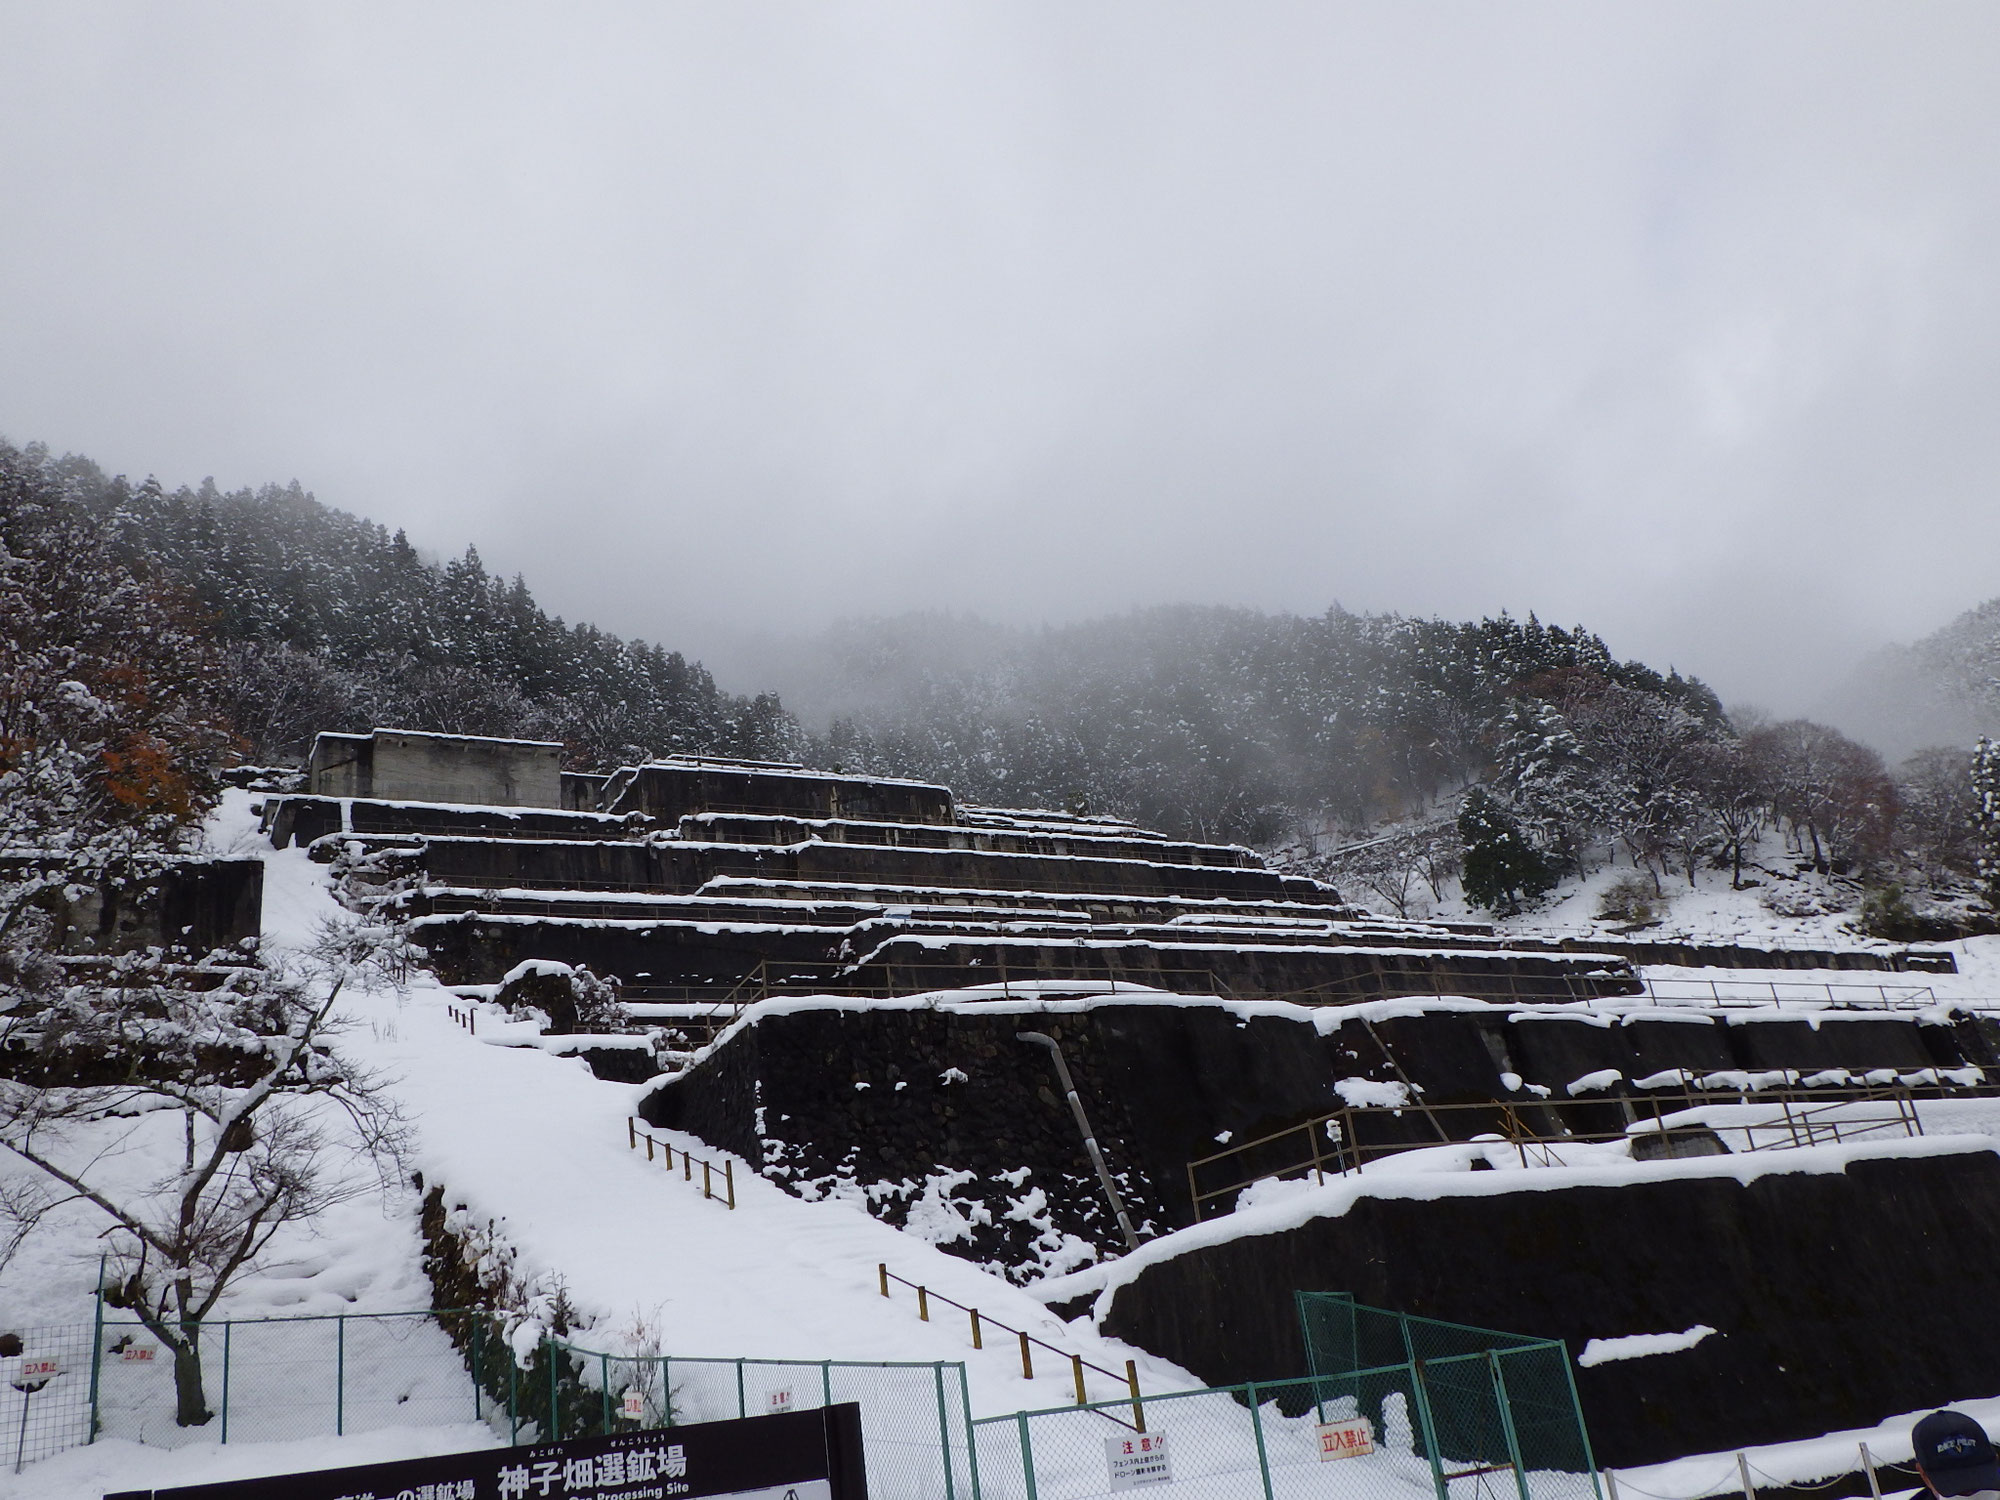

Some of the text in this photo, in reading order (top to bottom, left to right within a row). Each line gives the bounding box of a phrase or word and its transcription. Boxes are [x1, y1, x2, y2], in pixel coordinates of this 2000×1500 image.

[124, 1350, 154, 1360] 立入禁止
[24, 1362, 56, 1375] 立入禁止
[610, 1433, 666, 1448] せんこうじょう
[1322, 1427, 1369, 1452] 立入禁止
[529, 1447, 564, 1459] みこばた
[497, 1444, 688, 1500] 神子畑選鉱場
[666, 1482, 690, 1495] Site
